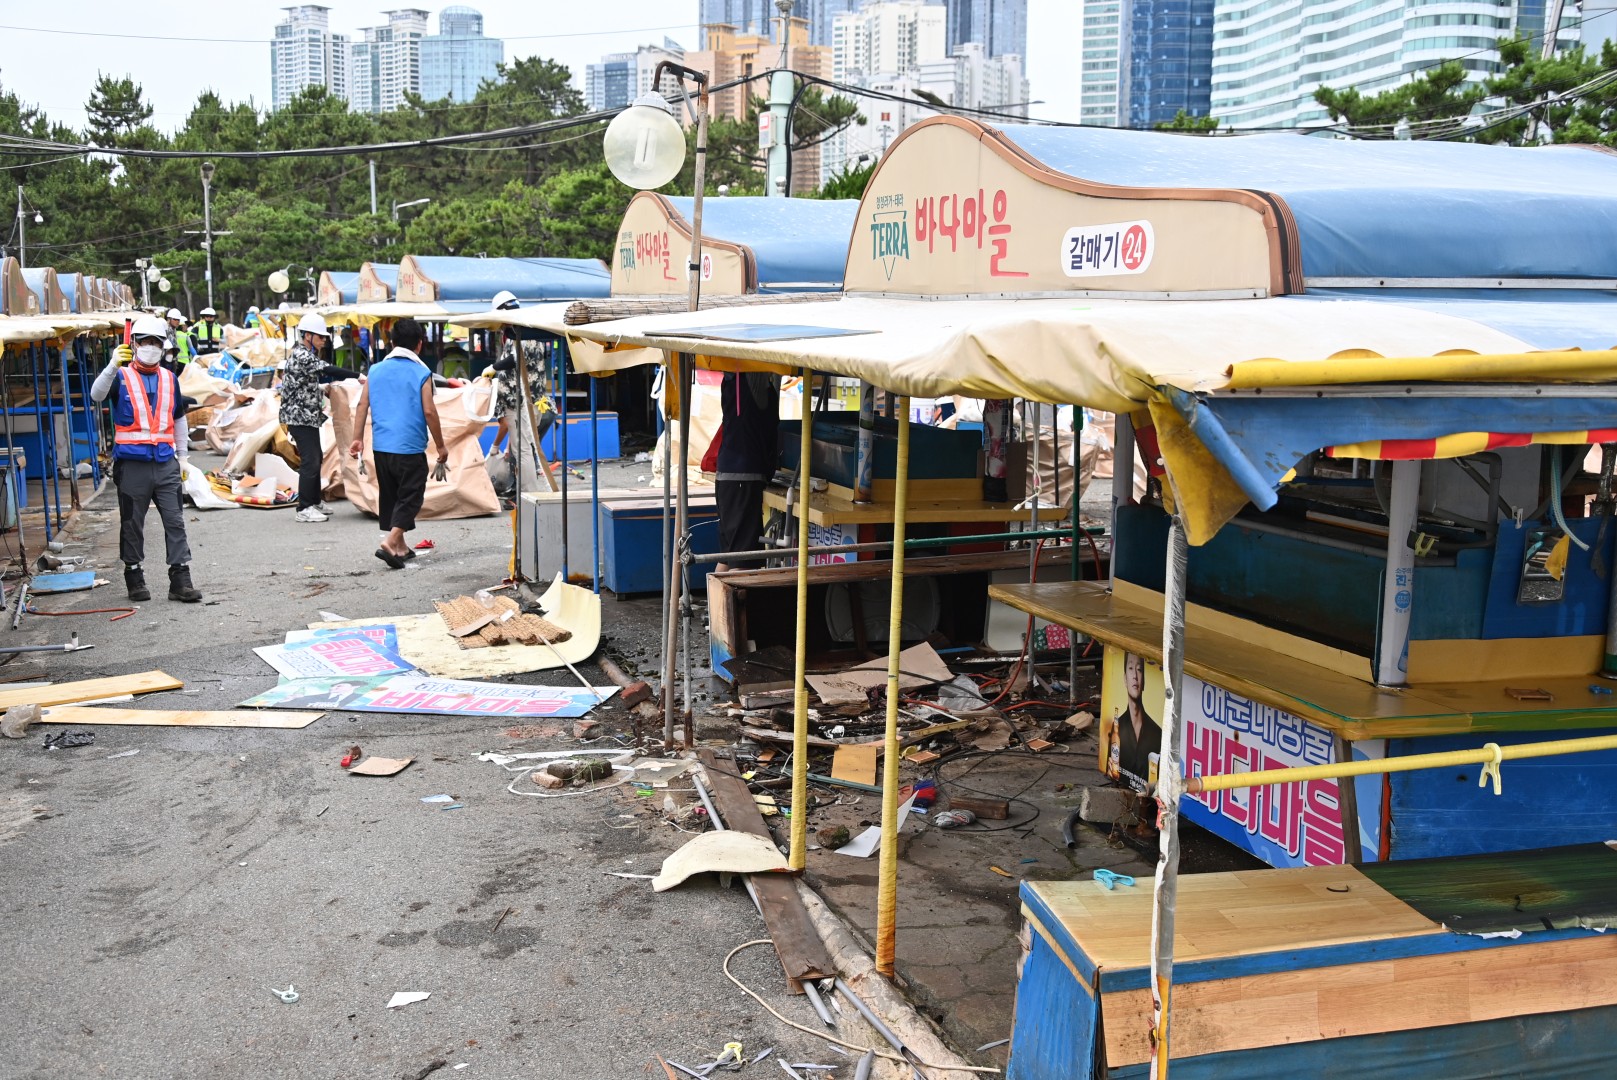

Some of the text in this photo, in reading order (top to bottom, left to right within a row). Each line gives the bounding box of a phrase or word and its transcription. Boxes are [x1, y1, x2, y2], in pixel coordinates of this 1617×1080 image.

[636, 230, 677, 280] 바다마을
[871, 220, 910, 260] TERRA
[915, 188, 1029, 277] 바다마을
[1069, 231, 1144, 270] 갈매기 24
[371, 690, 572, 714] 바다마을
[1186, 720, 1345, 867] 바다마을
